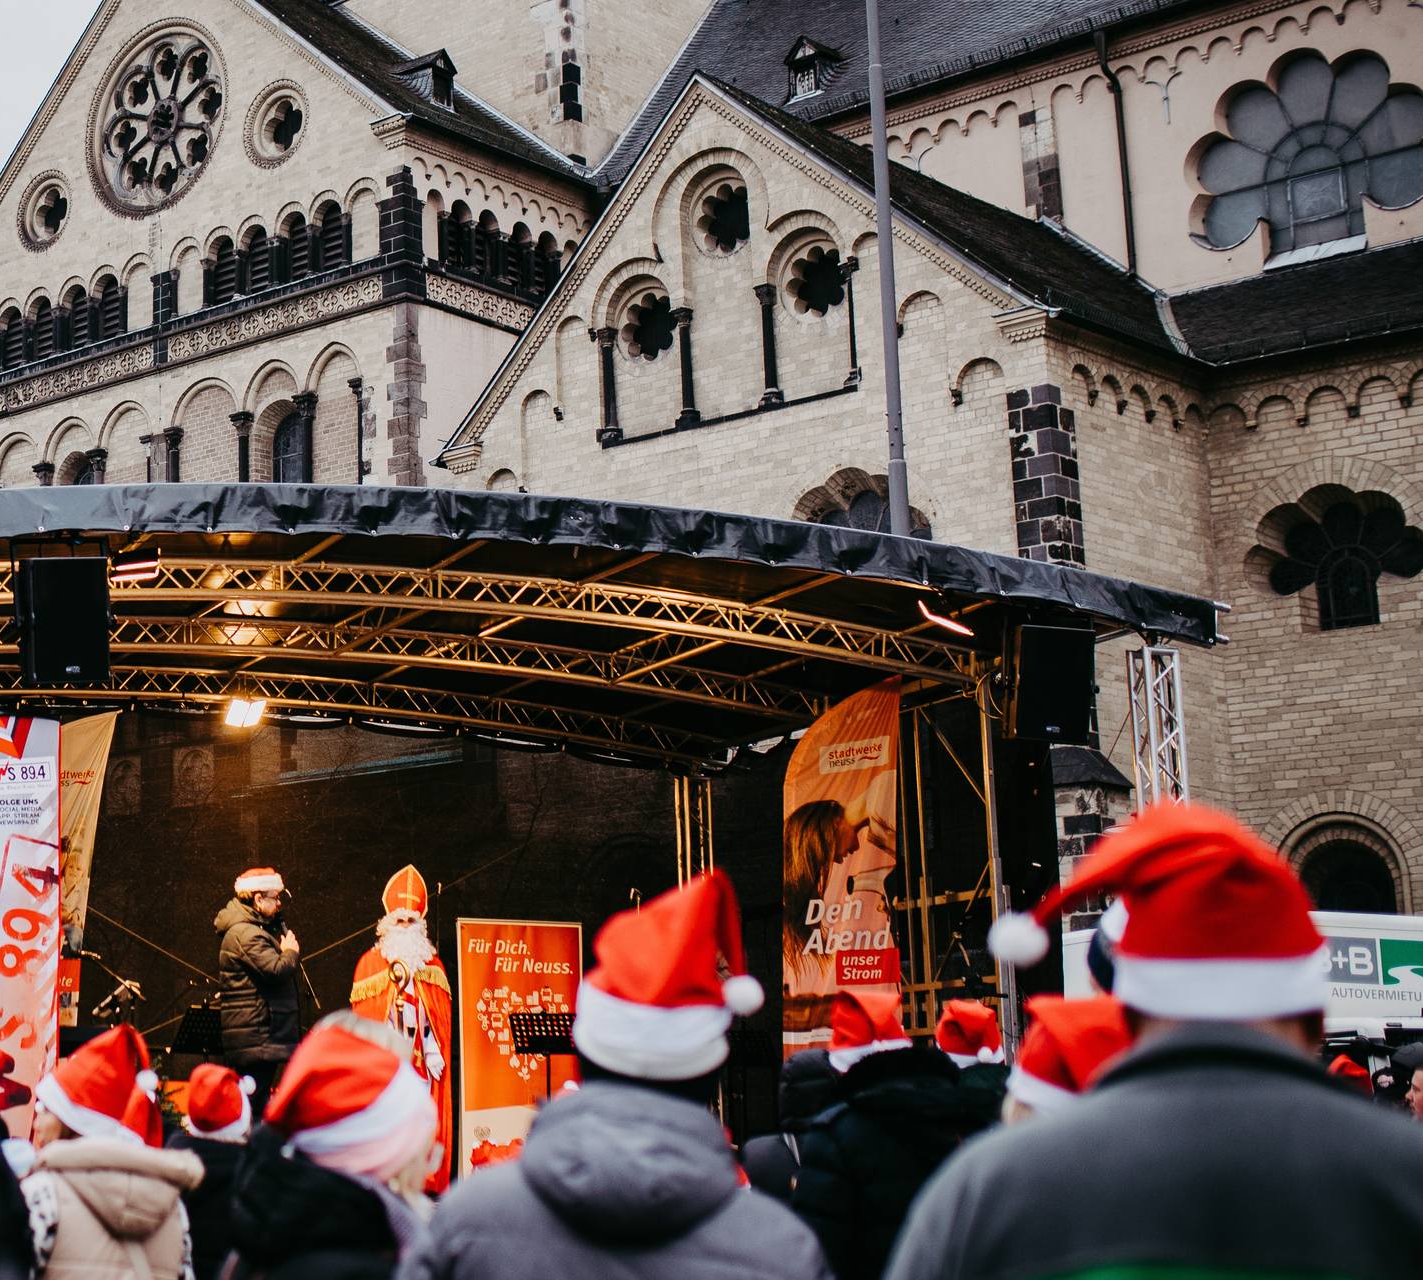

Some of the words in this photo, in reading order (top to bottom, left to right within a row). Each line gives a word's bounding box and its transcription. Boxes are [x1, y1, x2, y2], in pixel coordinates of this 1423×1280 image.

[827, 743, 883, 760] stadtwerke
[804, 894, 863, 926] Dein
[467, 938, 492, 954] Für
[494, 939, 531, 956] Dich.
[802, 921, 890, 955] Abend
[494, 957, 520, 974] Für
[522, 958, 574, 975] Neuss.
[841, 954, 881, 967] unser
[842, 967, 883, 980] Strom
